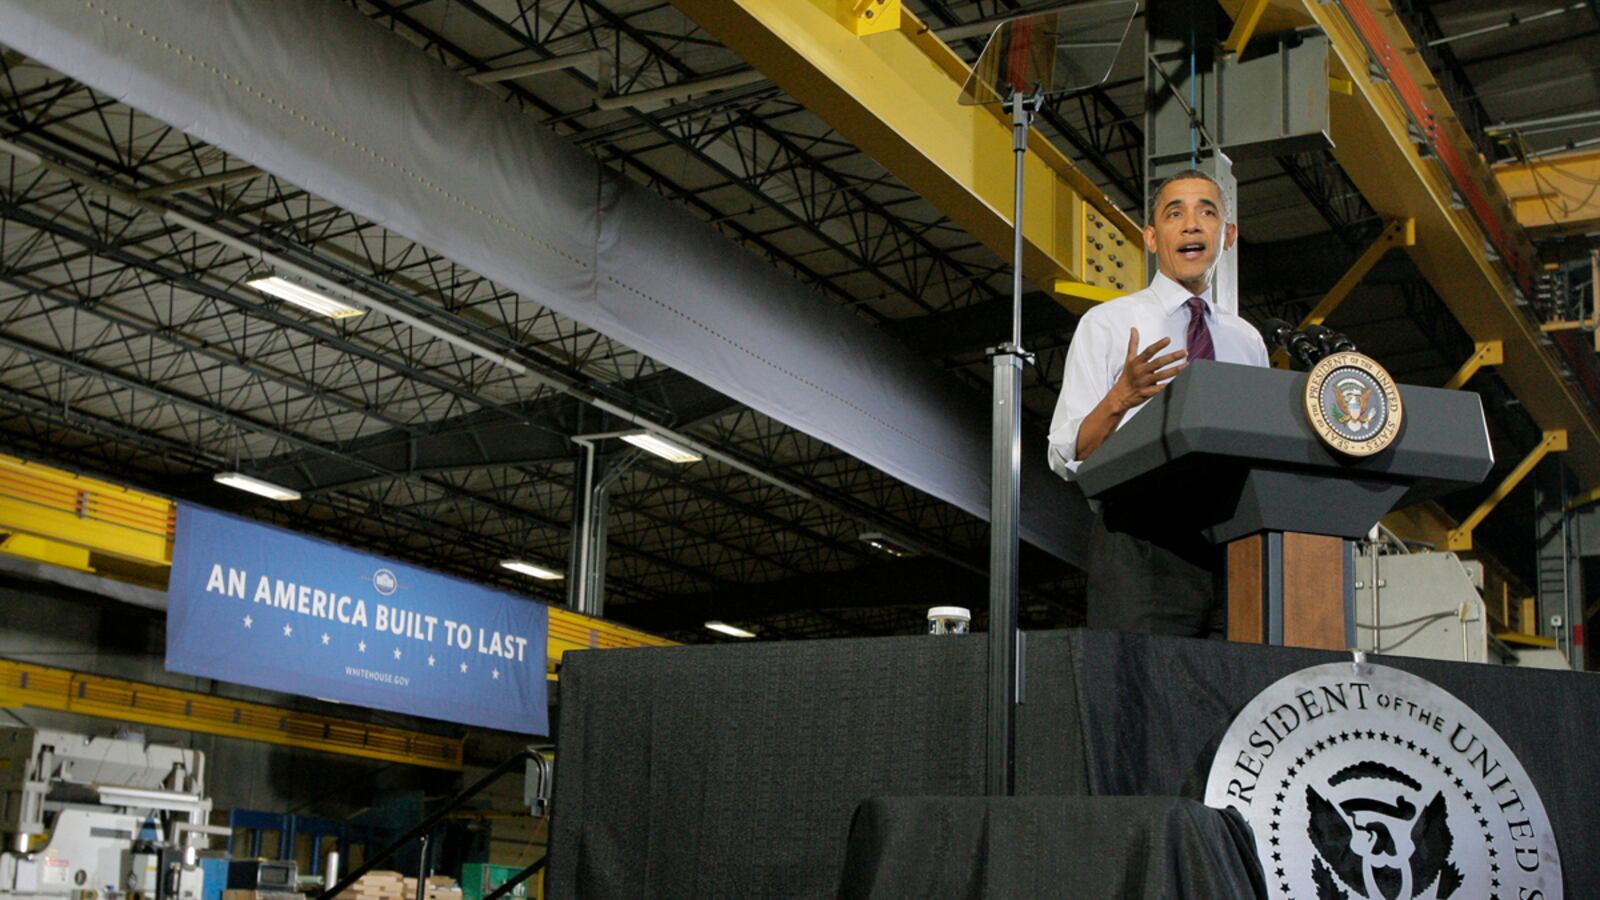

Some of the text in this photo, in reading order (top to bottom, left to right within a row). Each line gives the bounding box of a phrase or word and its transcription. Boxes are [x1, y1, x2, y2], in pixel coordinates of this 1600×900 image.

[1309, 355, 1349, 399] PRESIDENT
[1375, 370, 1398, 412] UNITED
[1324, 427, 1350, 450] SEAL
[1365, 420, 1396, 451] STATES
[206, 564, 527, 662] AN AMERICA BUILT TO LAST
[345, 666, 410, 686] WHITEHOUSE.GOV
[1226, 682, 1540, 872] RESIDENT OF THE UNITED
